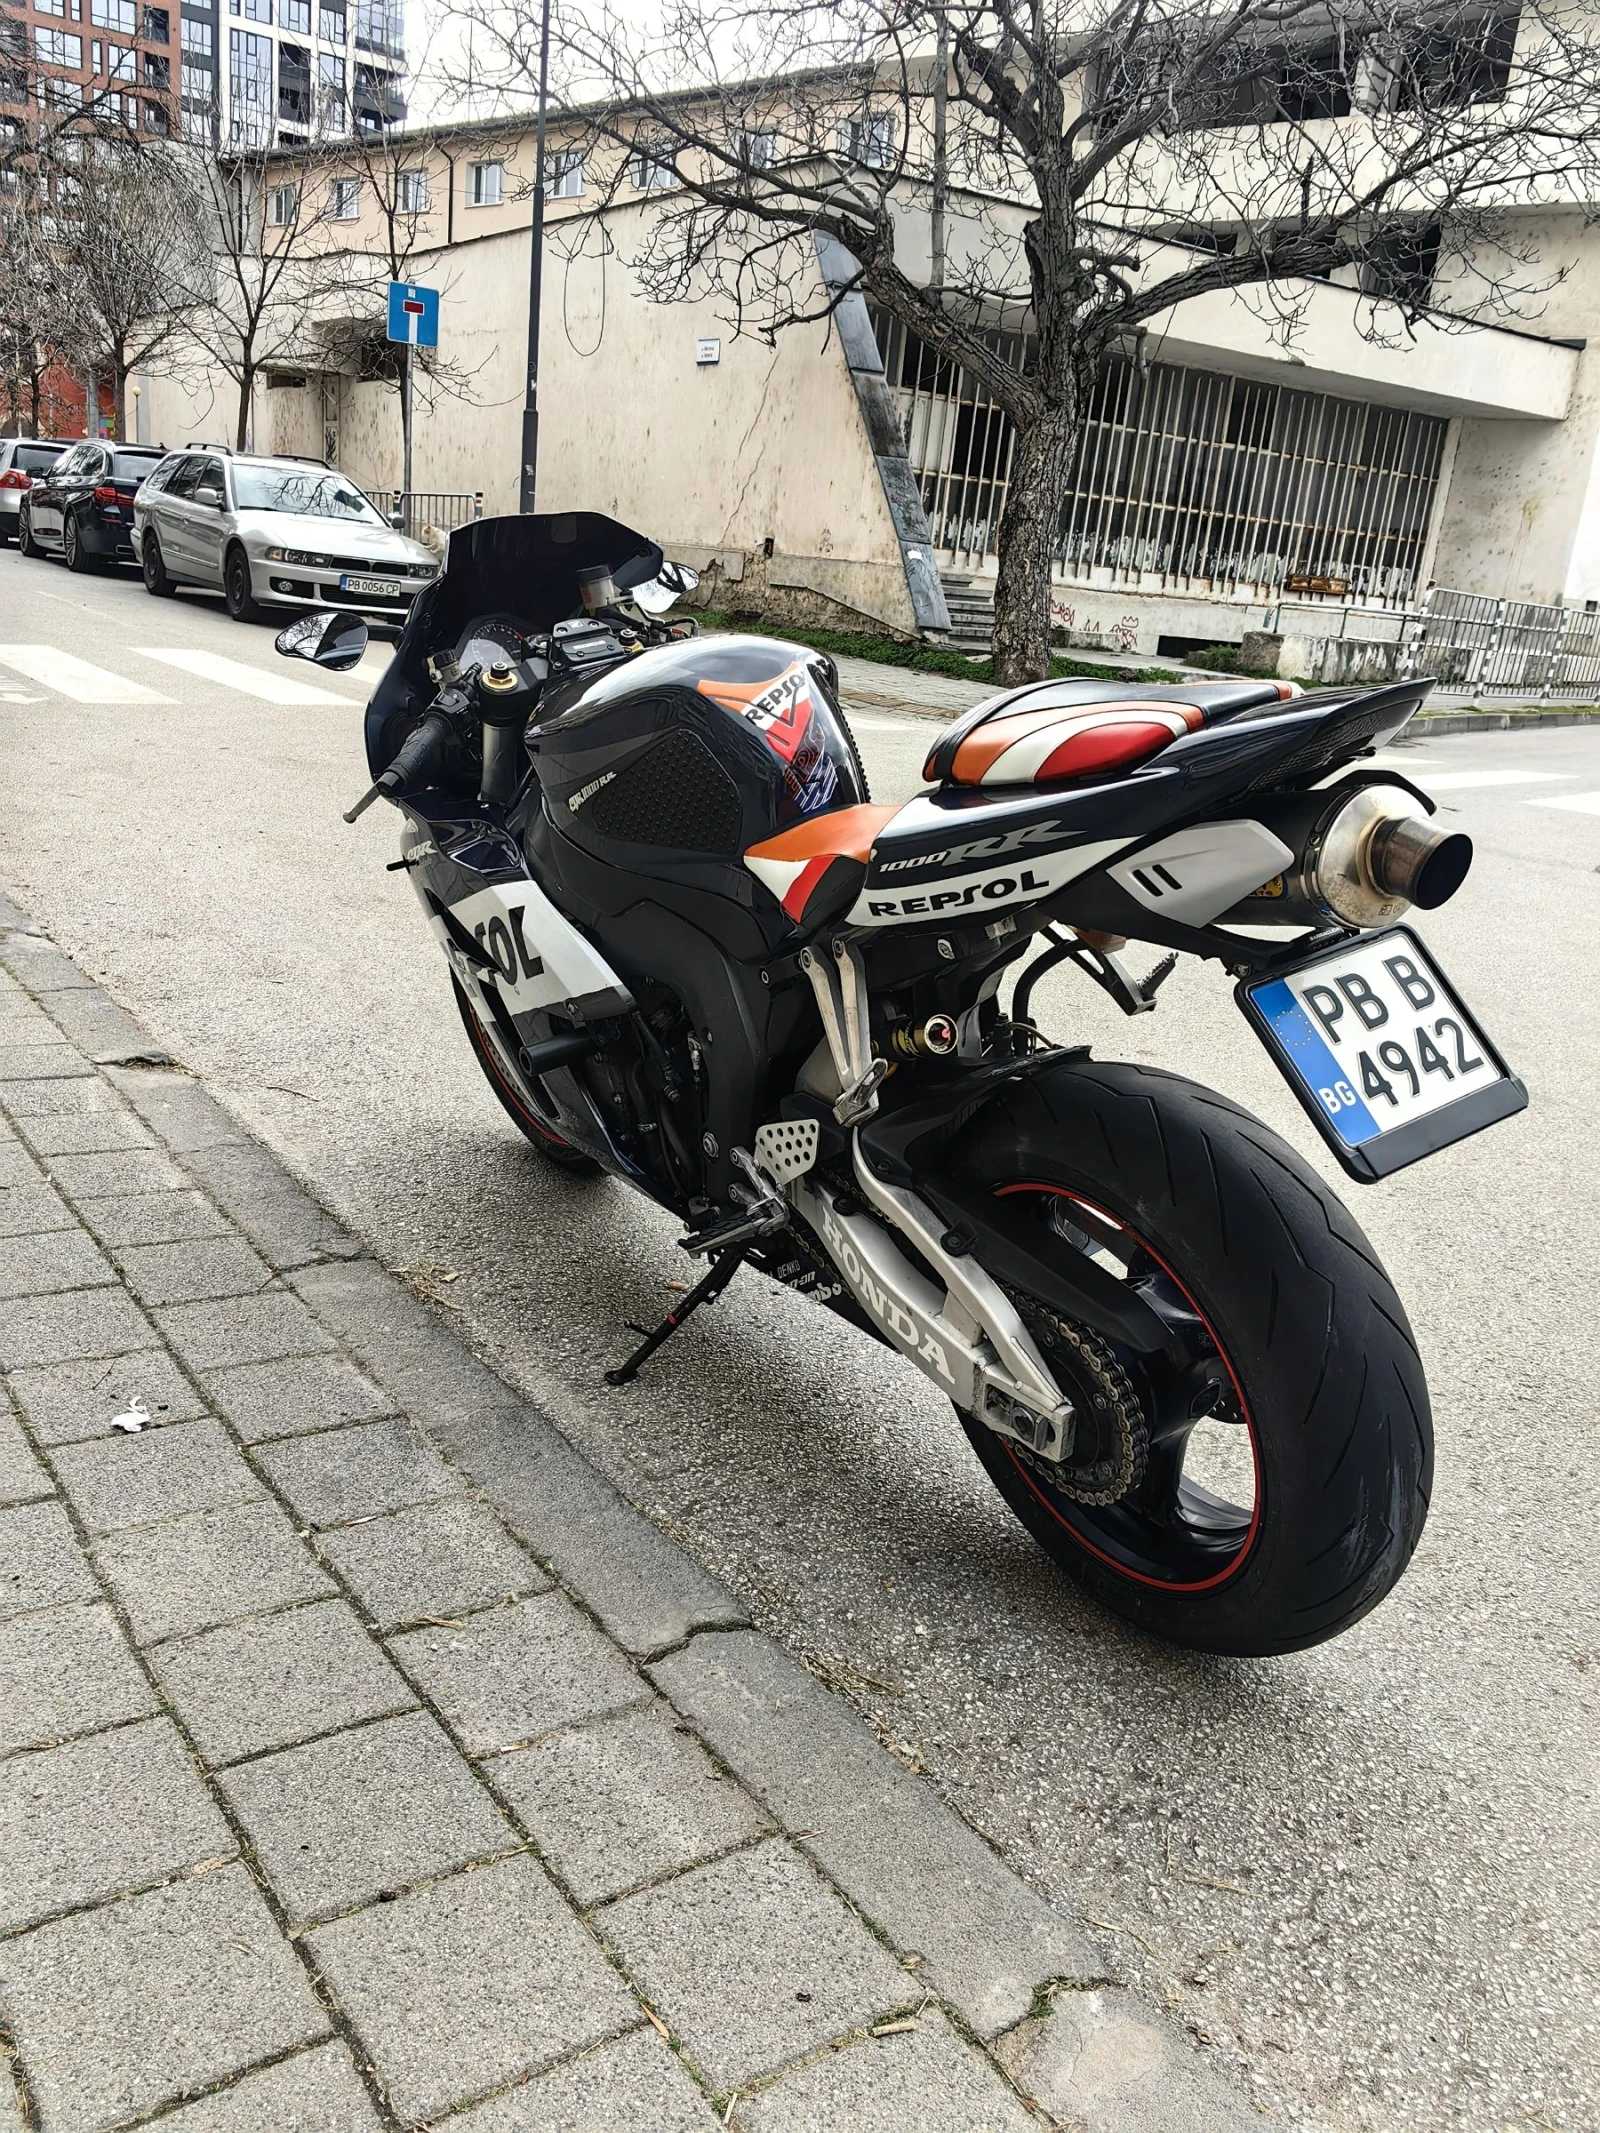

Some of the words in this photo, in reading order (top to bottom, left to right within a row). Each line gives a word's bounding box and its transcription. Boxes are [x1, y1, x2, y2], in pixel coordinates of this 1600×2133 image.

[347, 579, 360, 590] PB
[361, 581, 385, 593] 0056
[386, 584, 399, 595] CP
[867, 870, 1050, 918] REPSOL
[1301, 972, 1389, 1045] PB
[1381, 954, 1436, 1011] B
[1358, 1016, 1485, 1107] 4942
[1317, 1080, 1357, 1115] BG
[777, 1259, 801, 1279] DENKO
[822, 1206, 956, 1386] HONDA
